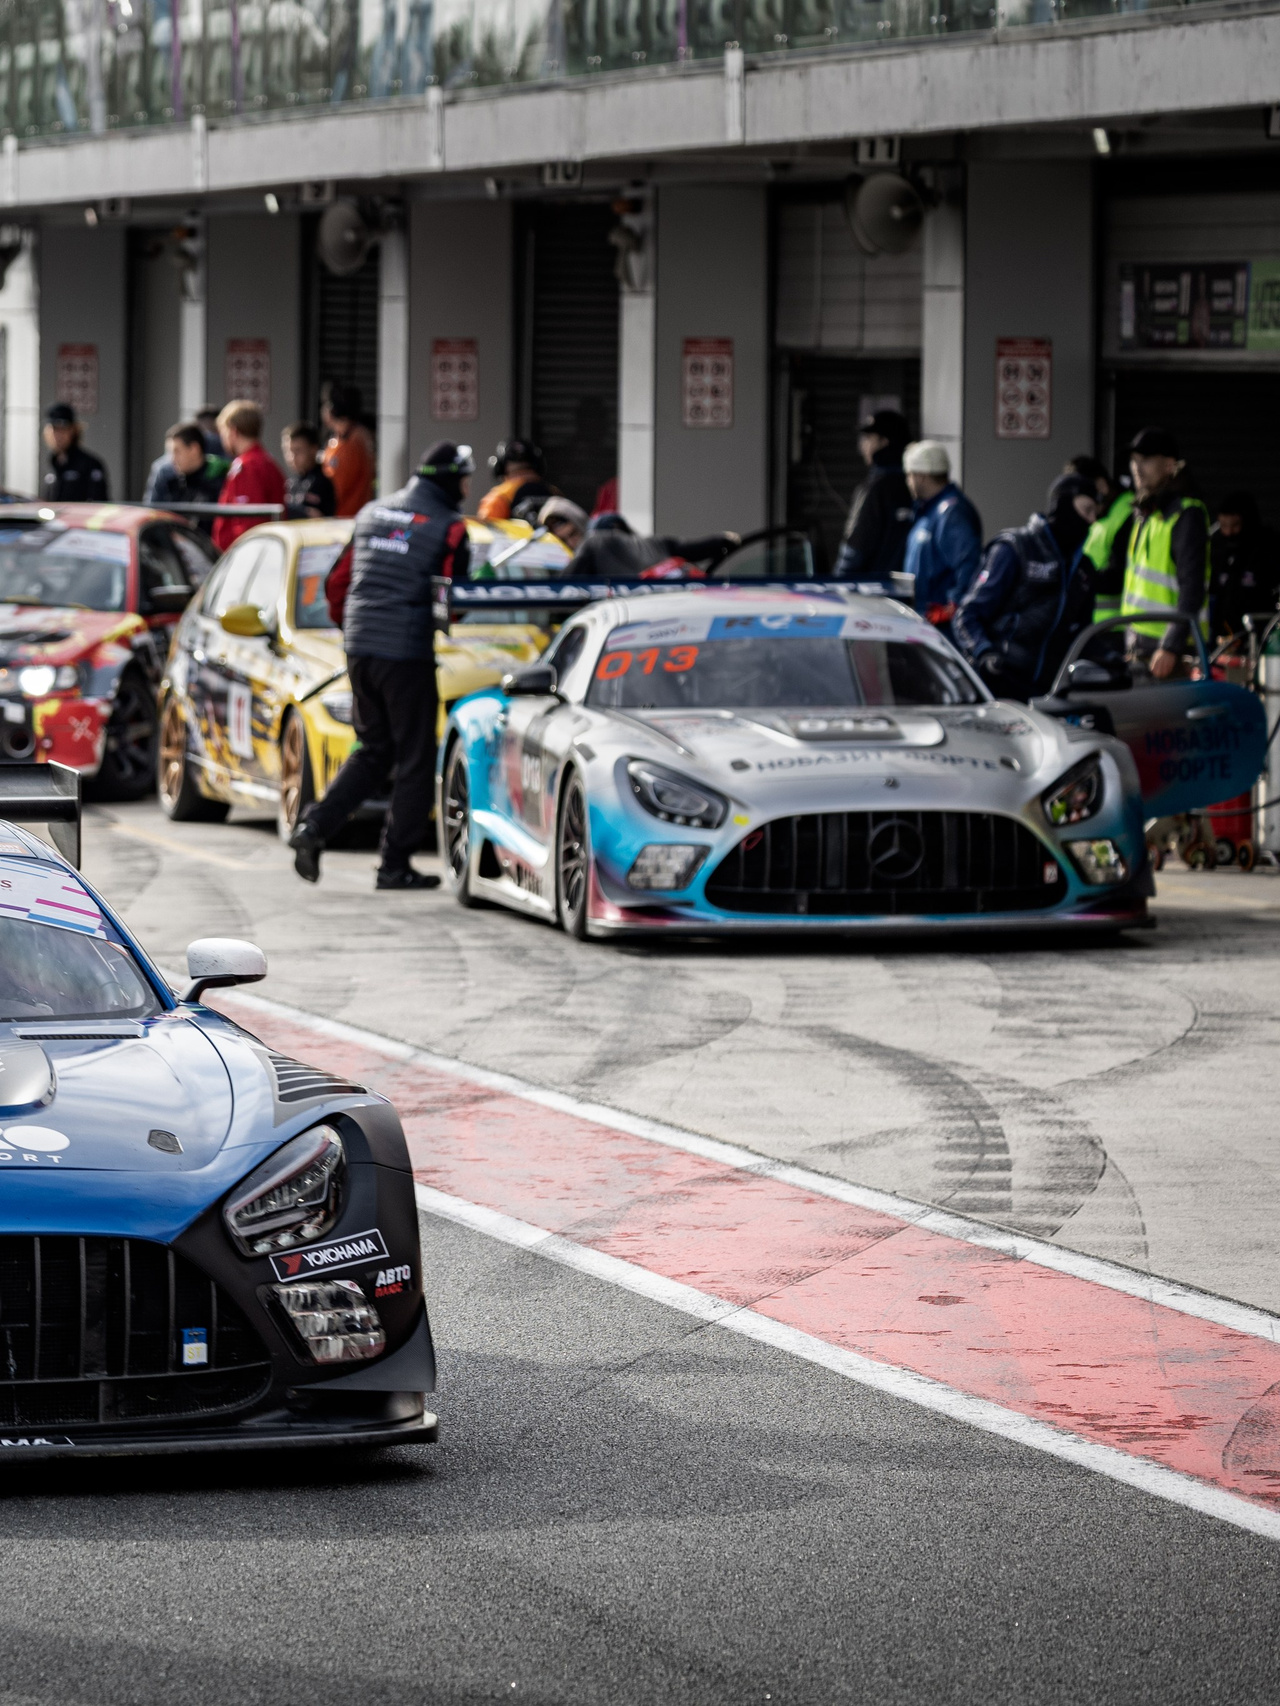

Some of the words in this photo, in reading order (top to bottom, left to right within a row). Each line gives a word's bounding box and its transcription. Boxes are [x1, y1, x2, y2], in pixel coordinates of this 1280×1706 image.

[595, 645, 700, 681] 013
[303, 1238, 379, 1267] YOKOHAMA
[375, 1264, 411, 1288] АВТО
